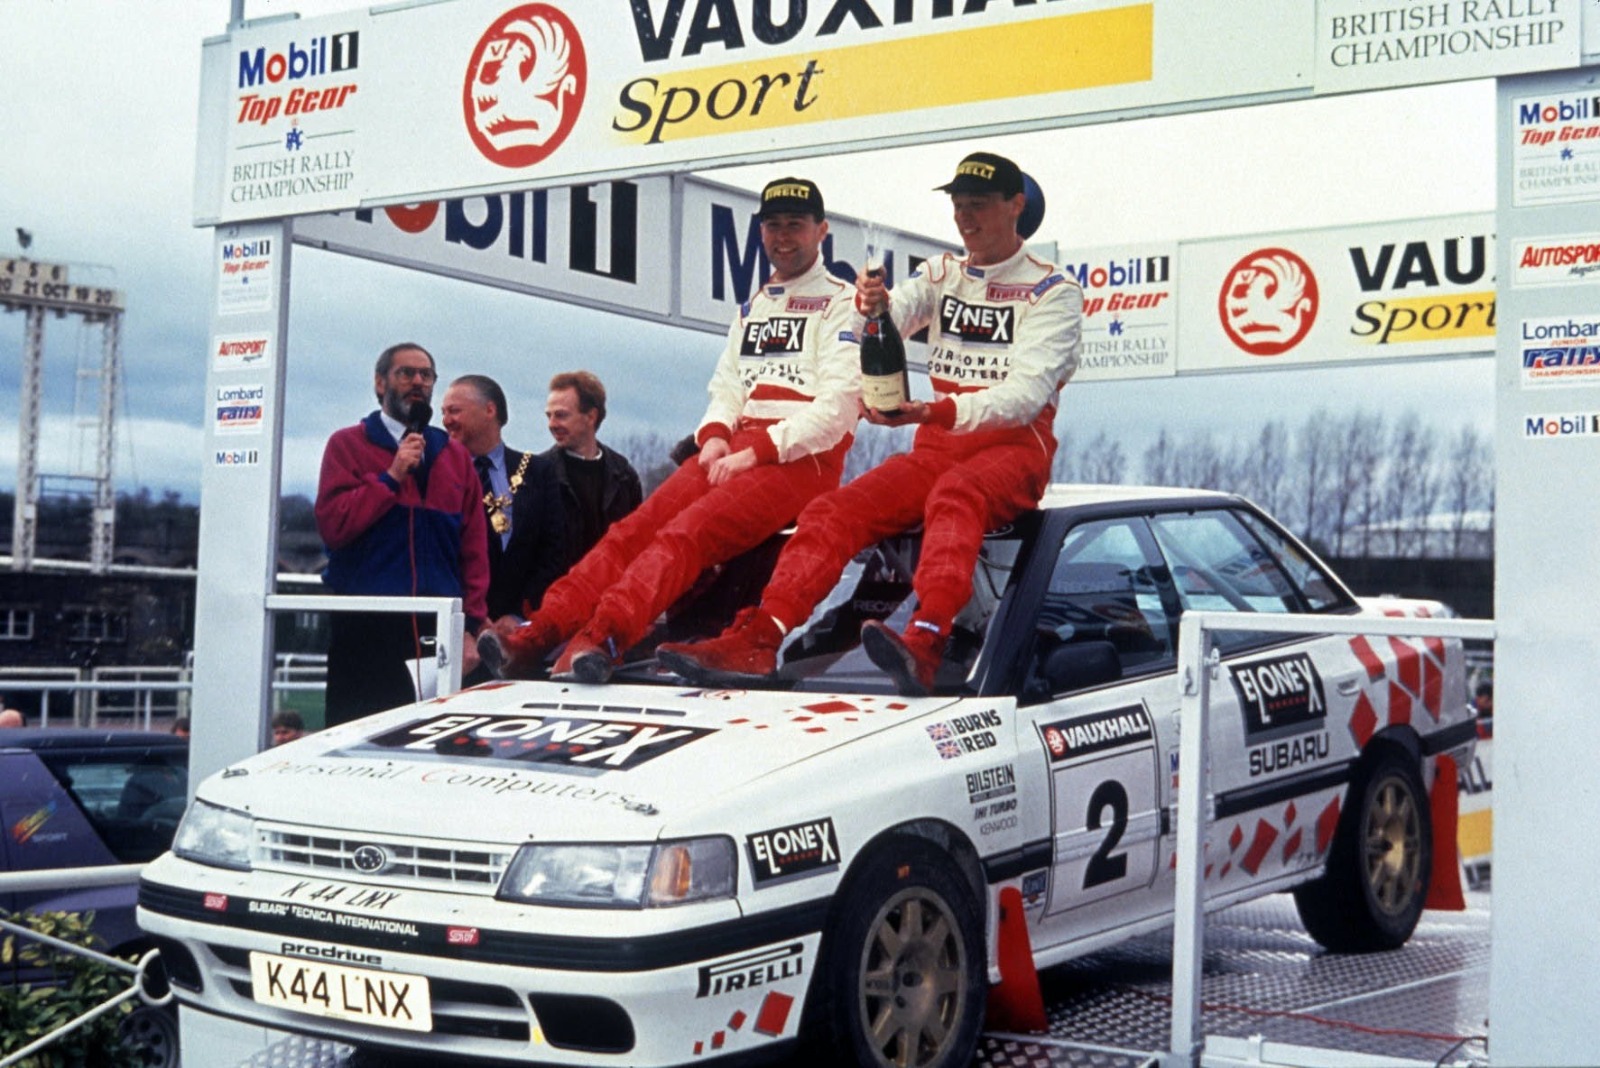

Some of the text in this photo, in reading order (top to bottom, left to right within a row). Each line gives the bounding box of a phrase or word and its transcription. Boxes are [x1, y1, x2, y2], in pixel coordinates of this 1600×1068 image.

[629, 0, 1057, 63] VAUX
[1331, 0, 1560, 39] BRITISH RALLY
[1330, 20, 1564, 67] CHAMPIONSHIP
[238, 37, 326, 88] Mobil
[237, 84, 358, 125] Top Gear
[612, 60, 823, 145] Sport
[1519, 97, 1589, 126] Mobil
[1520, 129, 1557, 146] Top
[232, 149, 354, 183] BRITISH RALLY
[1573, 159, 1600, 173] RAL
[230, 172, 355, 203] CHAMPIONSHIP
[222, 242, 258, 260] Mobil
[1349, 236, 1497, 292] VAU
[1519, 243, 1600, 269] AUTOSPOR
[1105, 291, 1170, 312] Gear
[943, 299, 1010, 342] ELNEX
[1522, 319, 1600, 340] Lombar
[219, 340, 267, 356] AUTOSPORT
[1081, 337, 1169, 355] ITISH RALLY
[1081, 351, 1169, 369] AMPIONSHIP
[1528, 367, 1600, 379] CHAMPIONSHI
[217, 386, 264, 402] Lombard
[1525, 416, 1586, 436] Mobil
[216, 451, 246, 465] Mobil
[1238, 657, 1324, 725] ELONEX
[952, 708, 1002, 735] BURNS
[1060, 711, 1150, 750] VAUXHALL
[404, 714, 694, 767] ELONEX
[962, 730, 998, 754] REID
[1248, 732, 1330, 778] SUBARU
[965, 763, 1016, 795] BILSTEIN
[988, 797, 1019, 817] TURBO
[752, 821, 836, 875] ELONEX
[1082, 779, 1130, 891] 2
[280, 881, 311, 898] K
[344, 889, 402, 911] LNX
[335, 913, 420, 937] INTERNATIONAL
[695, 941, 806, 999] PIRELLI
[266, 960, 414, 1022] K44 LNX
